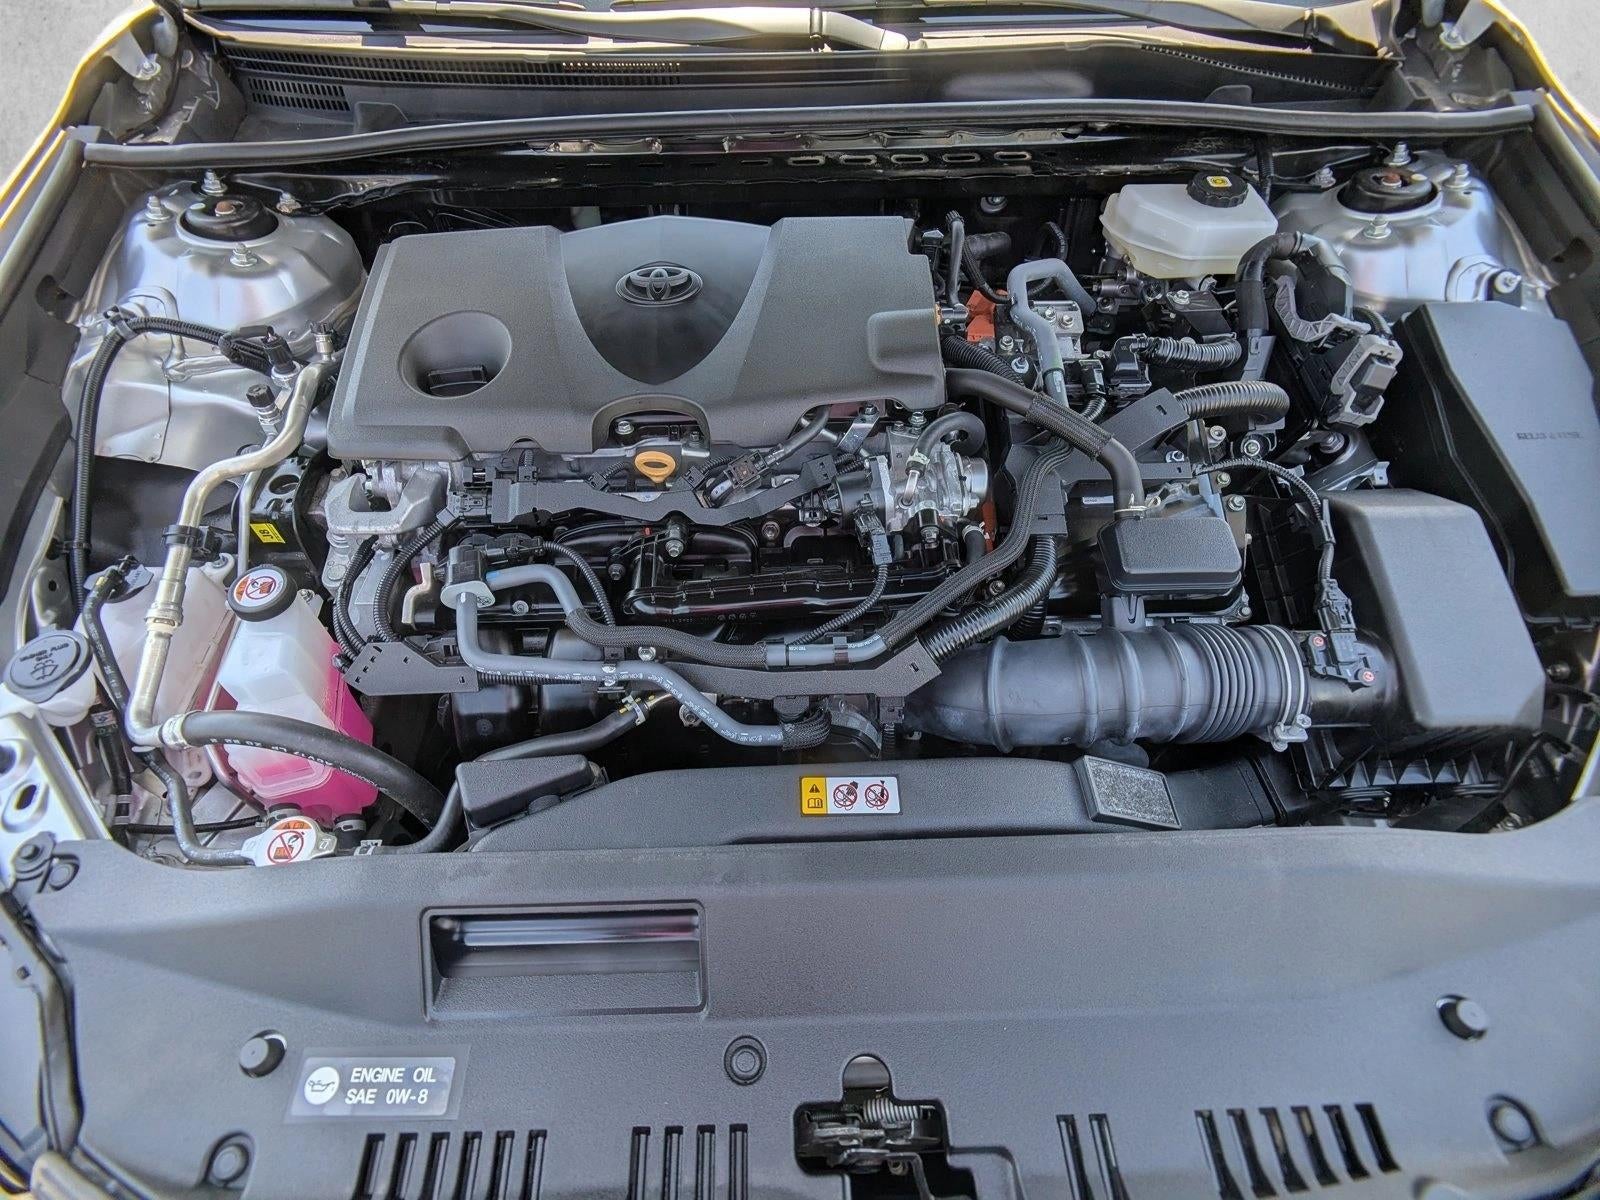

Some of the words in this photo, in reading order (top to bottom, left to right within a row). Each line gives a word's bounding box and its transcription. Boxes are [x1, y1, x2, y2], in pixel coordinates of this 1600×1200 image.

[350, 1067, 405, 1083] ENGINE
[413, 1067, 437, 1083] OIL
[345, 1088, 377, 1105] SAE
[386, 1088, 428, 1105] 0W-8
